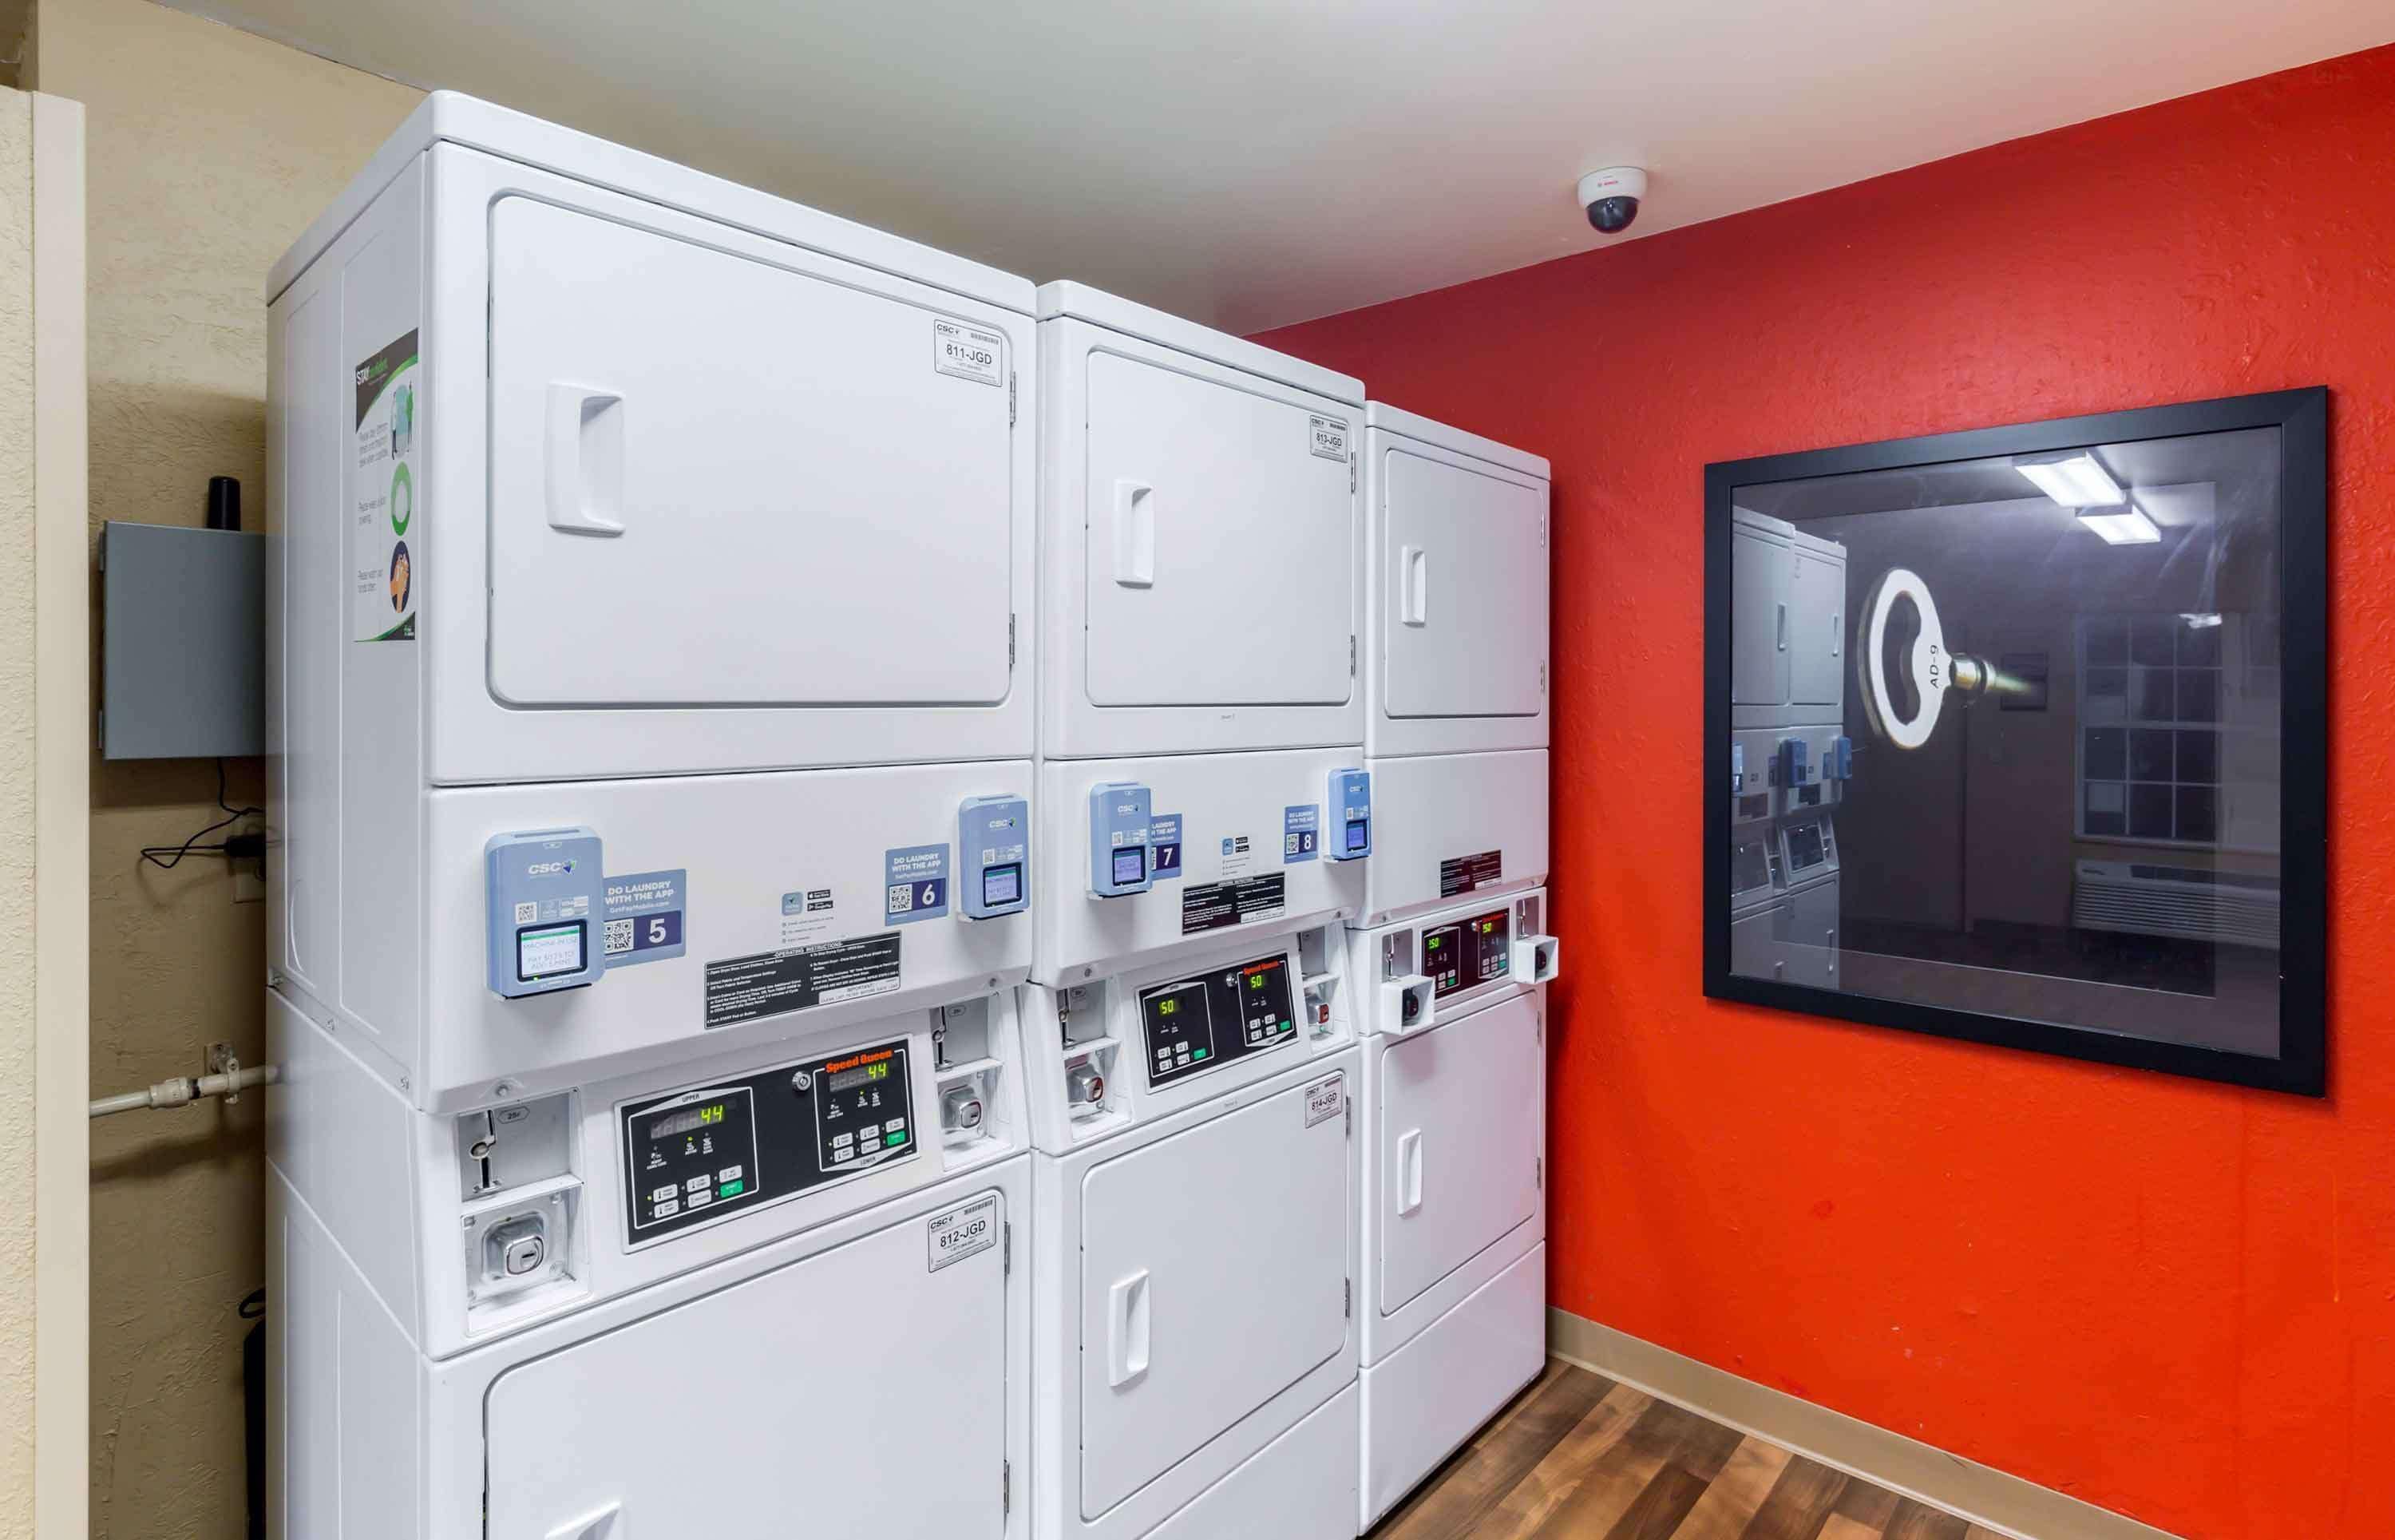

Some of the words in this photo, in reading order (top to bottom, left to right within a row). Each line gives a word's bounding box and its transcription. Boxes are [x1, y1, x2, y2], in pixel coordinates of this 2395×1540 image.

[936, 323, 954, 333] CSC
[946, 344, 992, 365] 811-JGD
[1316, 433, 1342, 446] 813-JGD
[1930, 644, 1939, 689] AD-9
[1304, 834, 1312, 850] 8
[906, 853, 940, 863] LAUNDRY
[1164, 848, 1173, 866] 7
[528, 862, 562, 874] CSC
[608, 886, 623, 896] DO
[625, 881, 671, 893] LAUNDRY
[922, 884, 936, 905] 6
[604, 894, 632, 905] WITH
[633, 891, 654, 901] THE
[655, 889, 675, 899] APP
[648, 918, 667, 944] 5
[1251, 975, 1261, 988] 50
[1161, 1000, 1174, 1014] 50
[825, 1055, 859, 1073] Speed
[861, 1049, 893, 1064] Queen
[869, 1063, 886, 1079] 44
[682, 1093, 700, 1103] UPPER
[1312, 1093, 1337, 1110] 814-JGD
[702, 1104, 722, 1124] 44
[930, 1217, 948, 1229] CSC
[940, 1220, 986, 1247] 812-JGD
